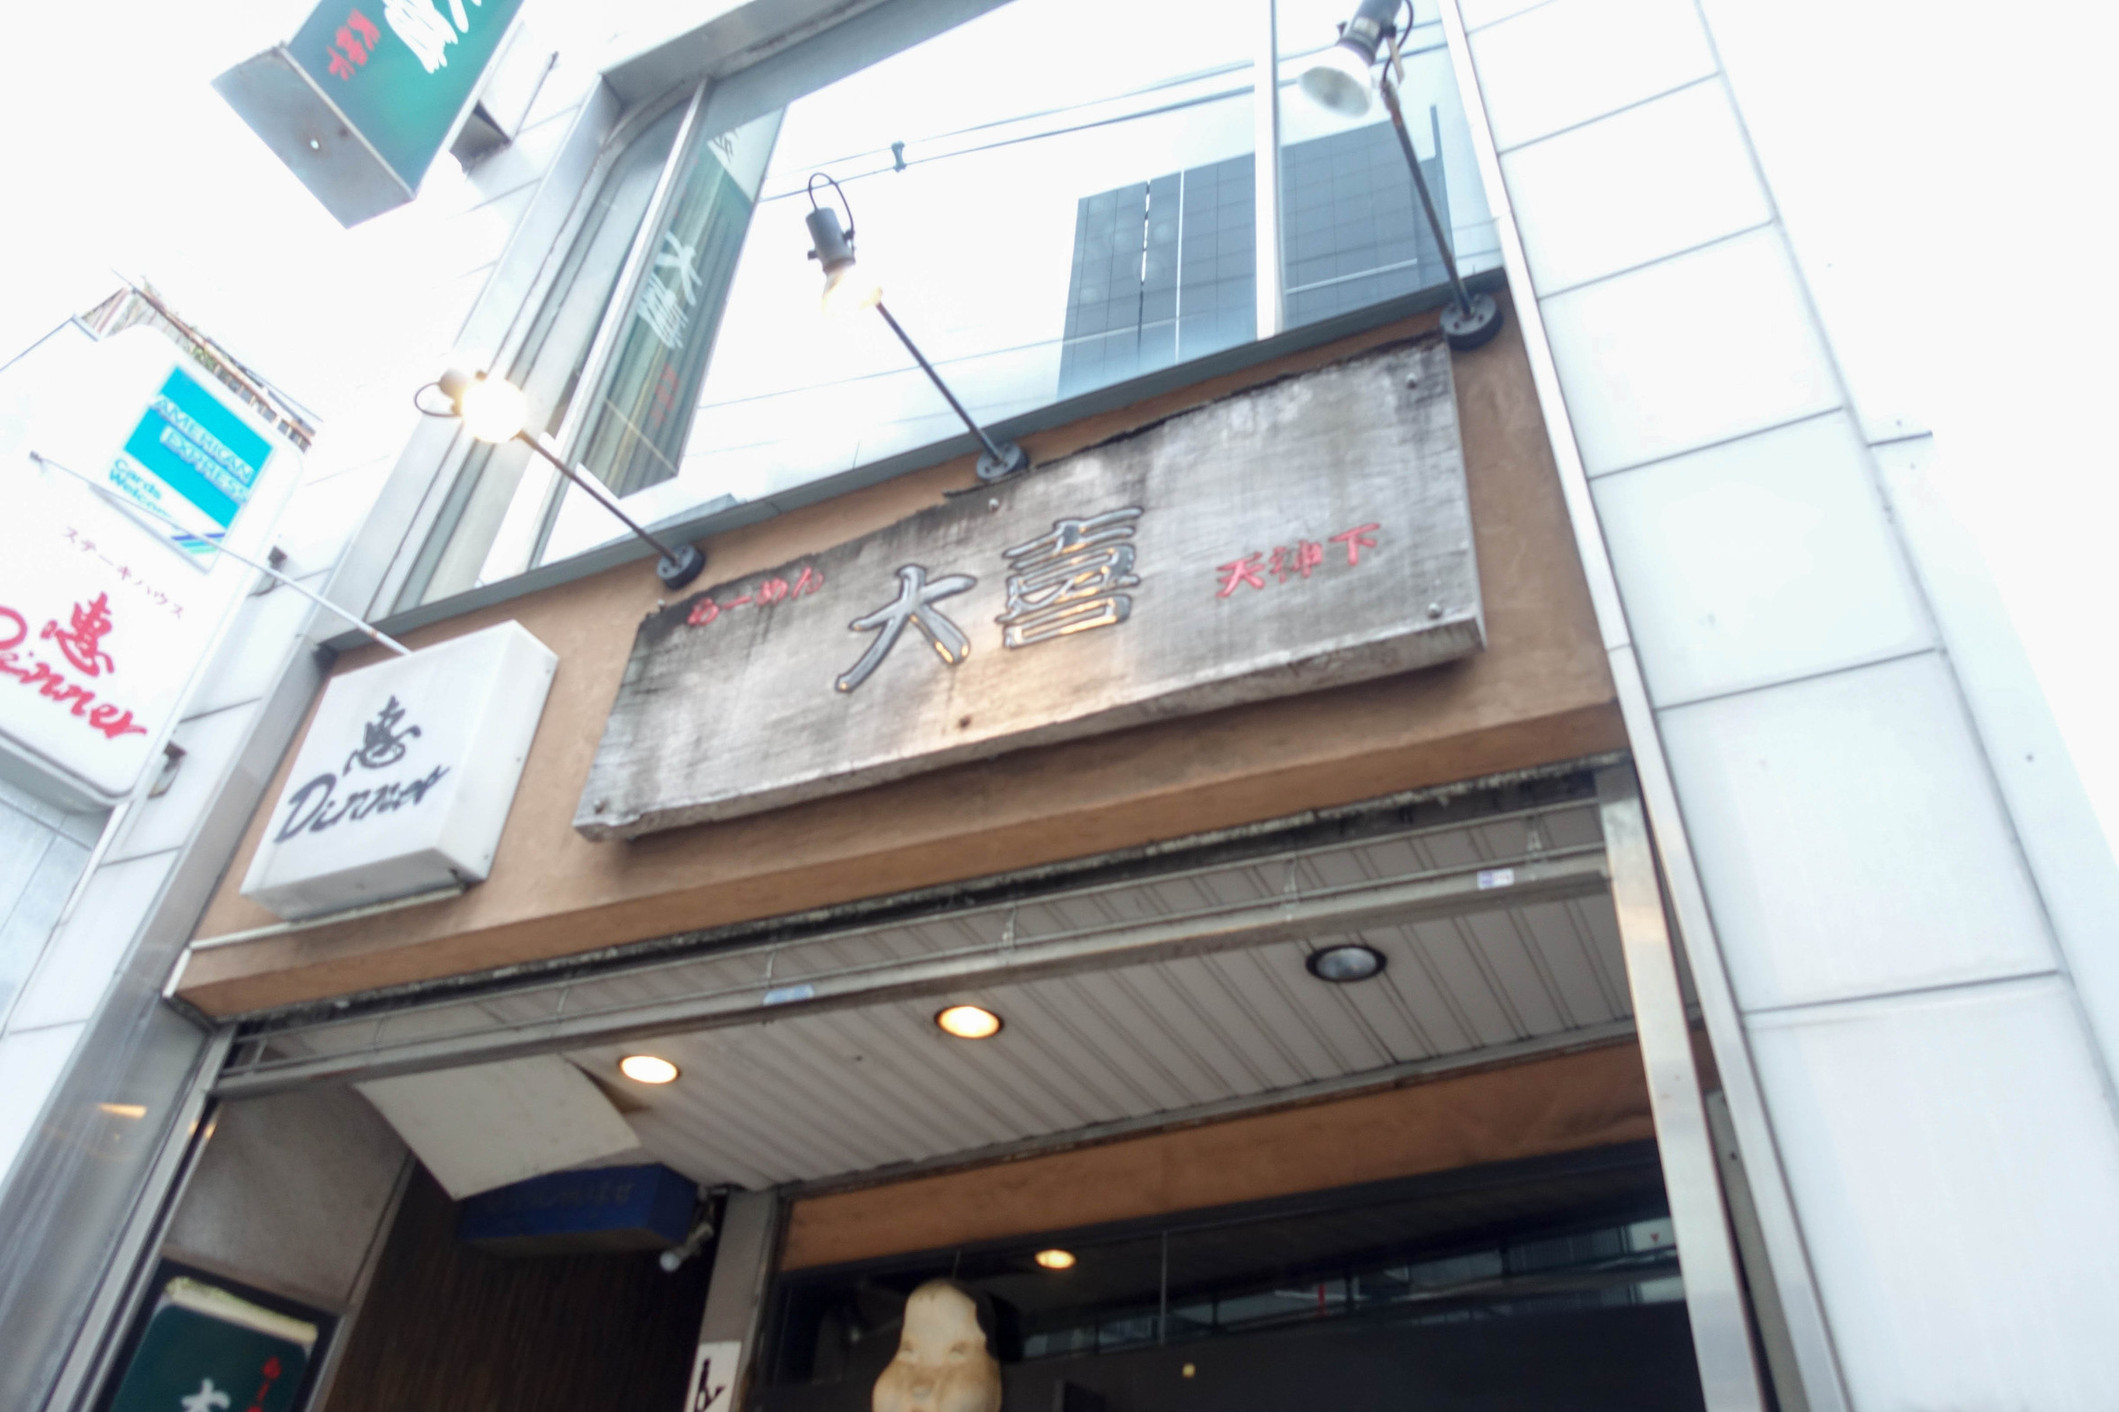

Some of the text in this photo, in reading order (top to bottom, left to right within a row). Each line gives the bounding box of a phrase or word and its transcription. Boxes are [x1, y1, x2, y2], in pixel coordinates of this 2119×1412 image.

[114, 458, 162, 500] Cards
[152, 397, 257, 486] AMERICAN
[160, 424, 251, 504] EXPRESS
[64, 526, 185, 619] ステーキハウス
[686, 565, 825, 627] らーめん
[834, 505, 1145, 694] 大喜
[1214, 522, 1382, 600] 天神下
